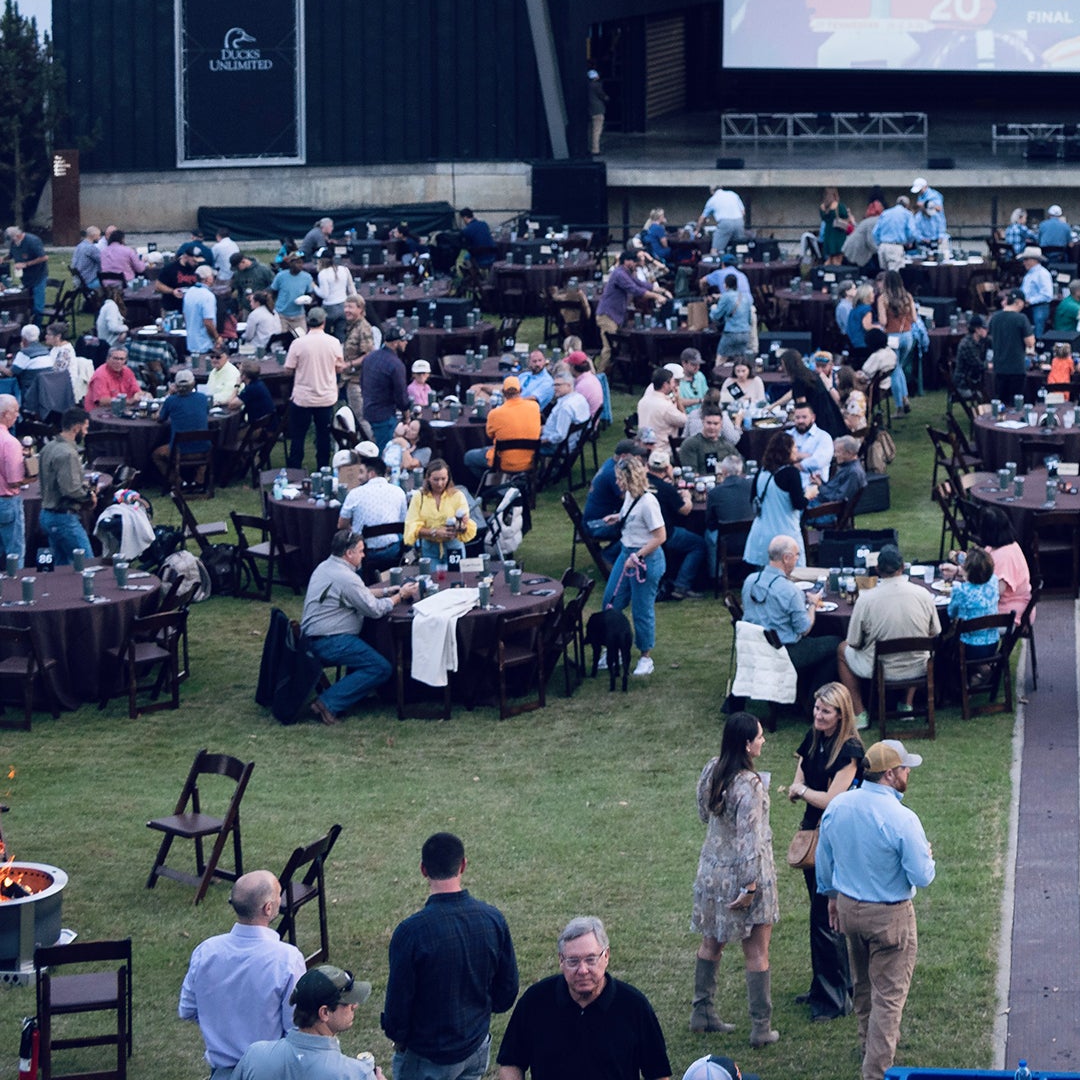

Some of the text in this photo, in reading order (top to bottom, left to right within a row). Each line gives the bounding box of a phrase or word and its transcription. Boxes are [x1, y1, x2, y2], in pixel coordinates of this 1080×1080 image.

[1026, 11, 1075, 25] FINAL
[39, 554, 53, 564] 86
[449, 554, 461, 564] 87
